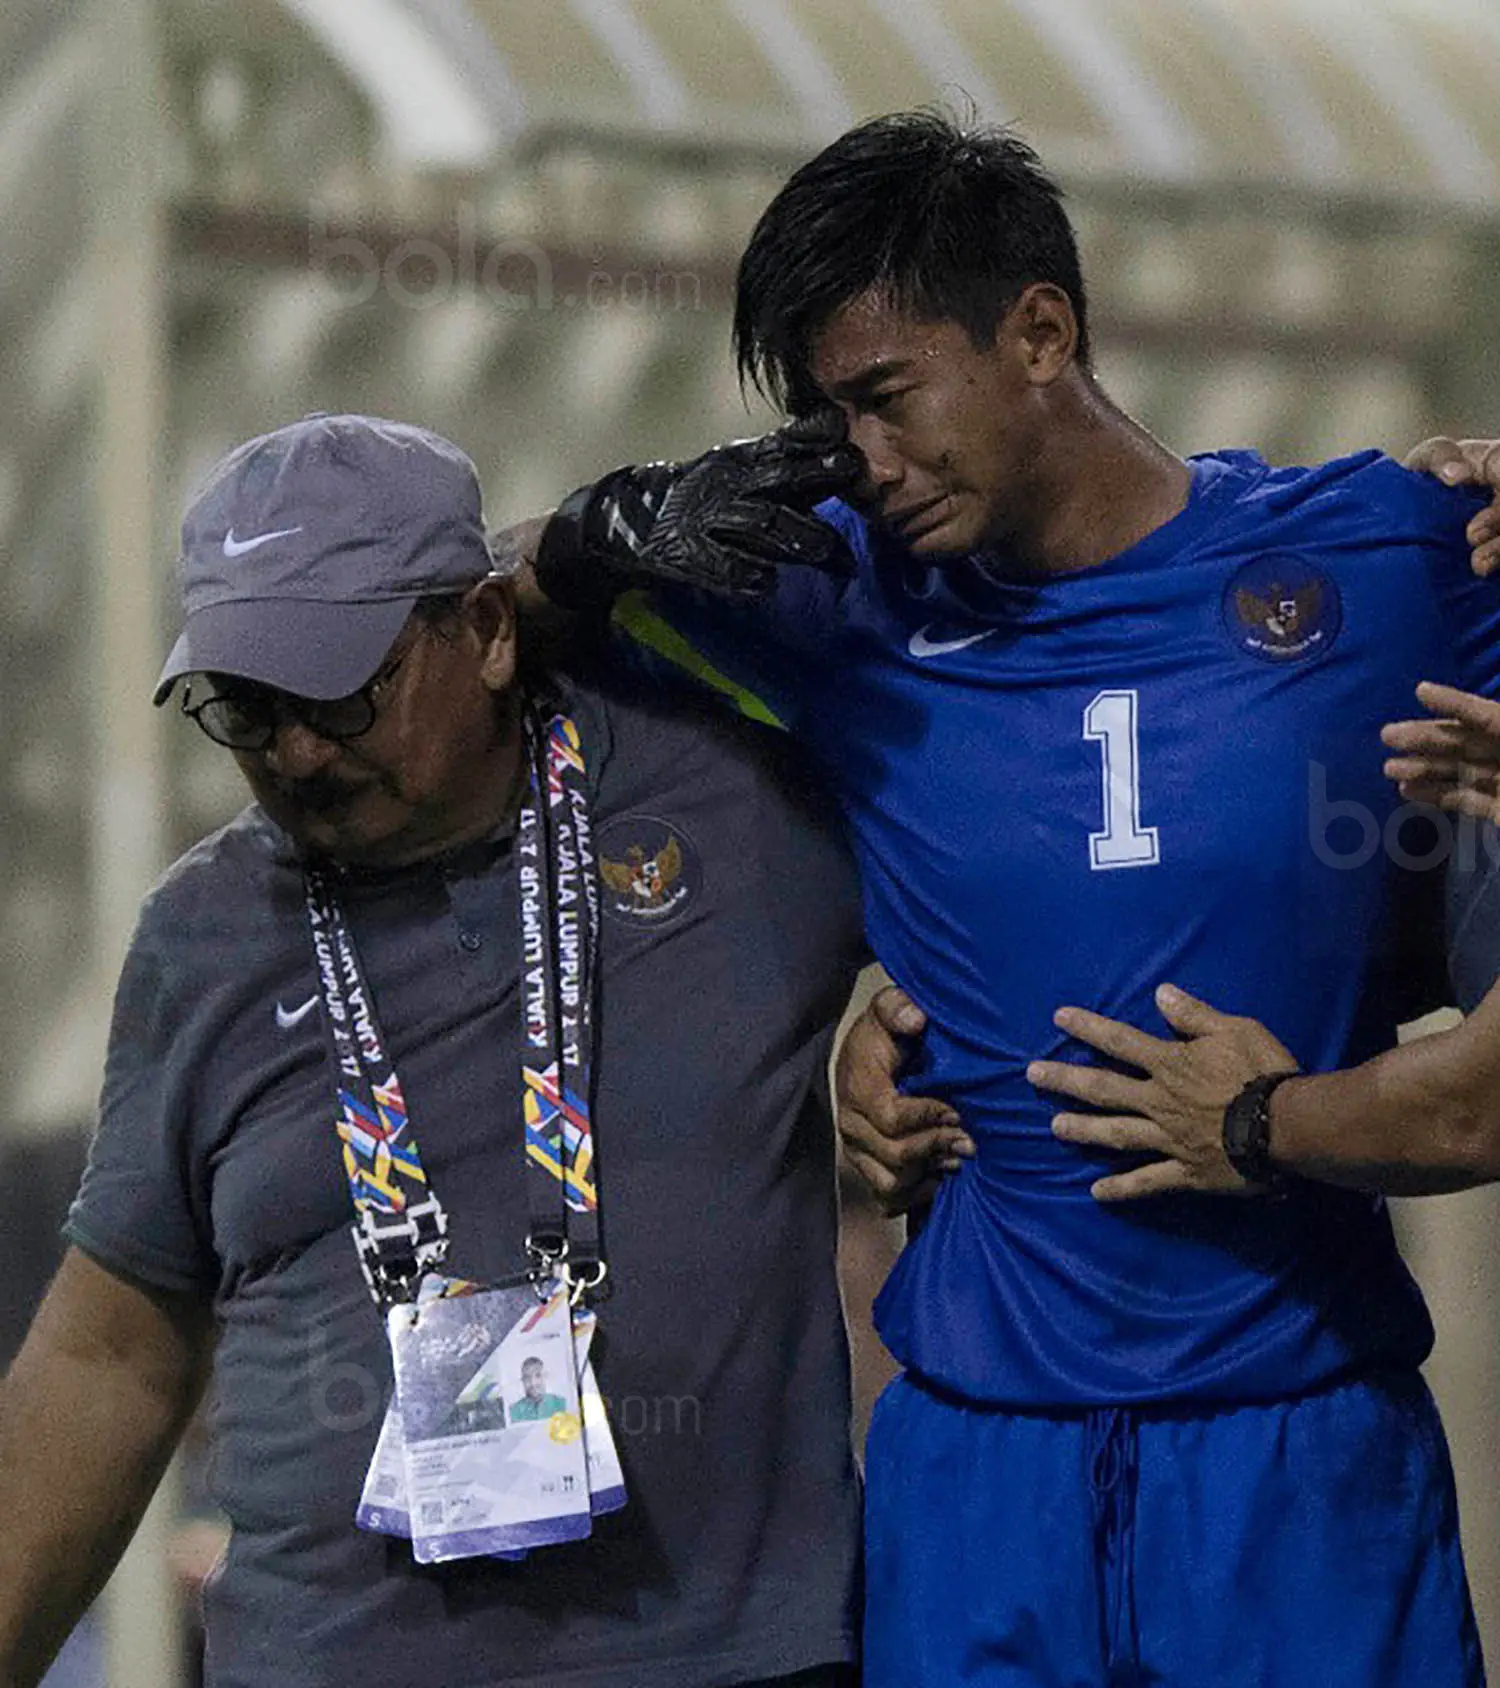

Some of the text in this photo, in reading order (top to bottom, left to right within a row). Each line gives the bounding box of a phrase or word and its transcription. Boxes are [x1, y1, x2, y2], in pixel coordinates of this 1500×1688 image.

[1083, 689, 1161, 870] 1
[520, 866, 544, 962] LUMPUR
[559, 911, 580, 1006] LUMPUR
[313, 931, 346, 1021] LUMPUR
[526, 966, 548, 1047] KUALA
